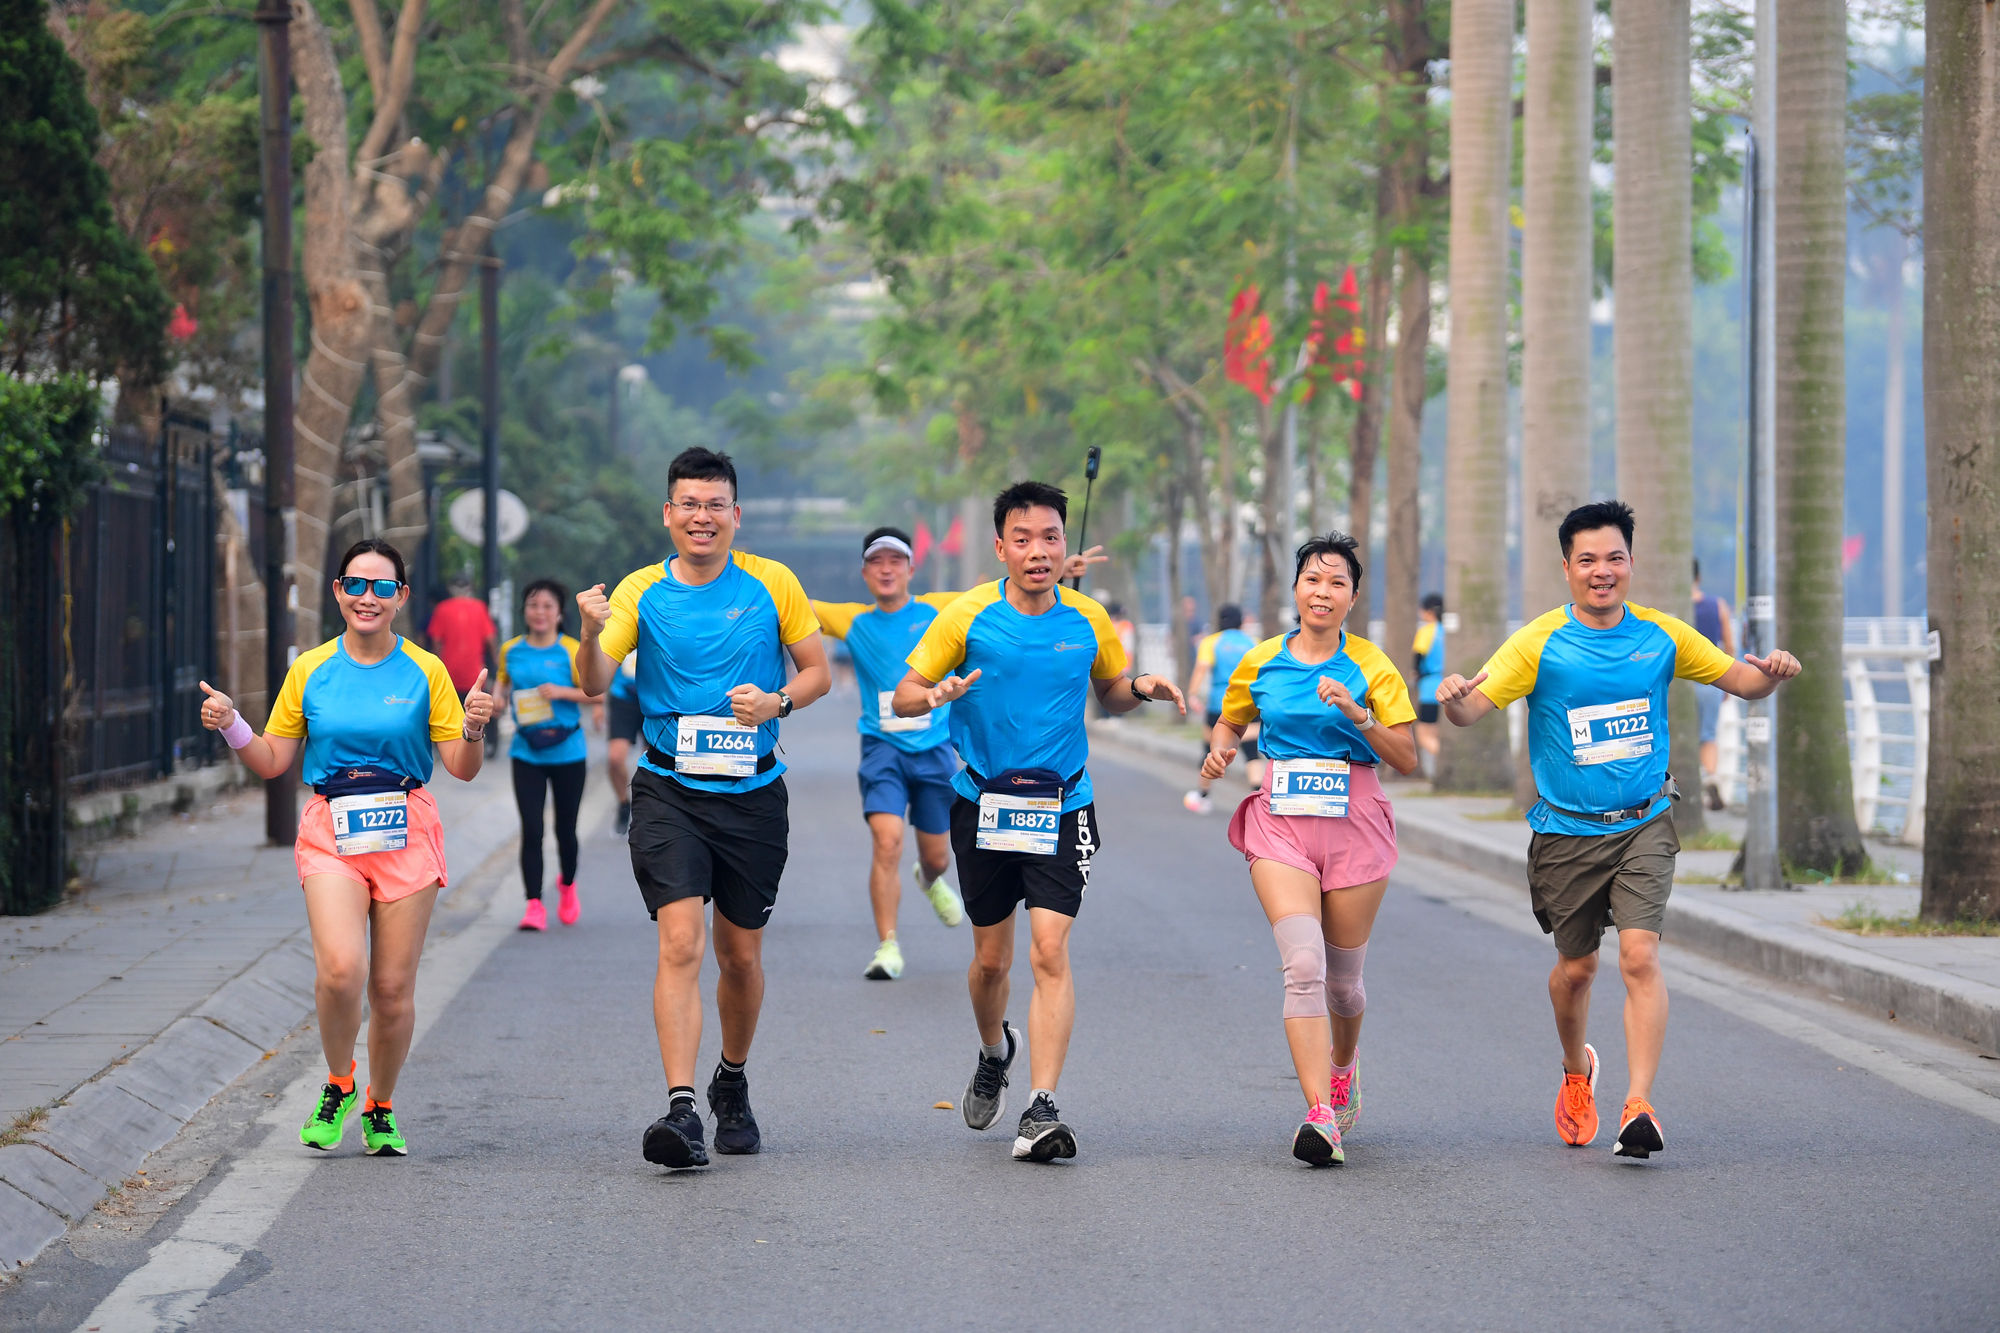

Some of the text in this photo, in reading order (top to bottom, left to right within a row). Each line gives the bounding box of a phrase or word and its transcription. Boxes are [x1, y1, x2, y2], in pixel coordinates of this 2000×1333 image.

[1574, 715, 1649, 739] M 11222
[680, 733, 755, 751] M 12664
[1277, 775, 1346, 792] F 17304
[337, 809, 405, 829] F 12272
[982, 811, 1056, 830] M 18873
